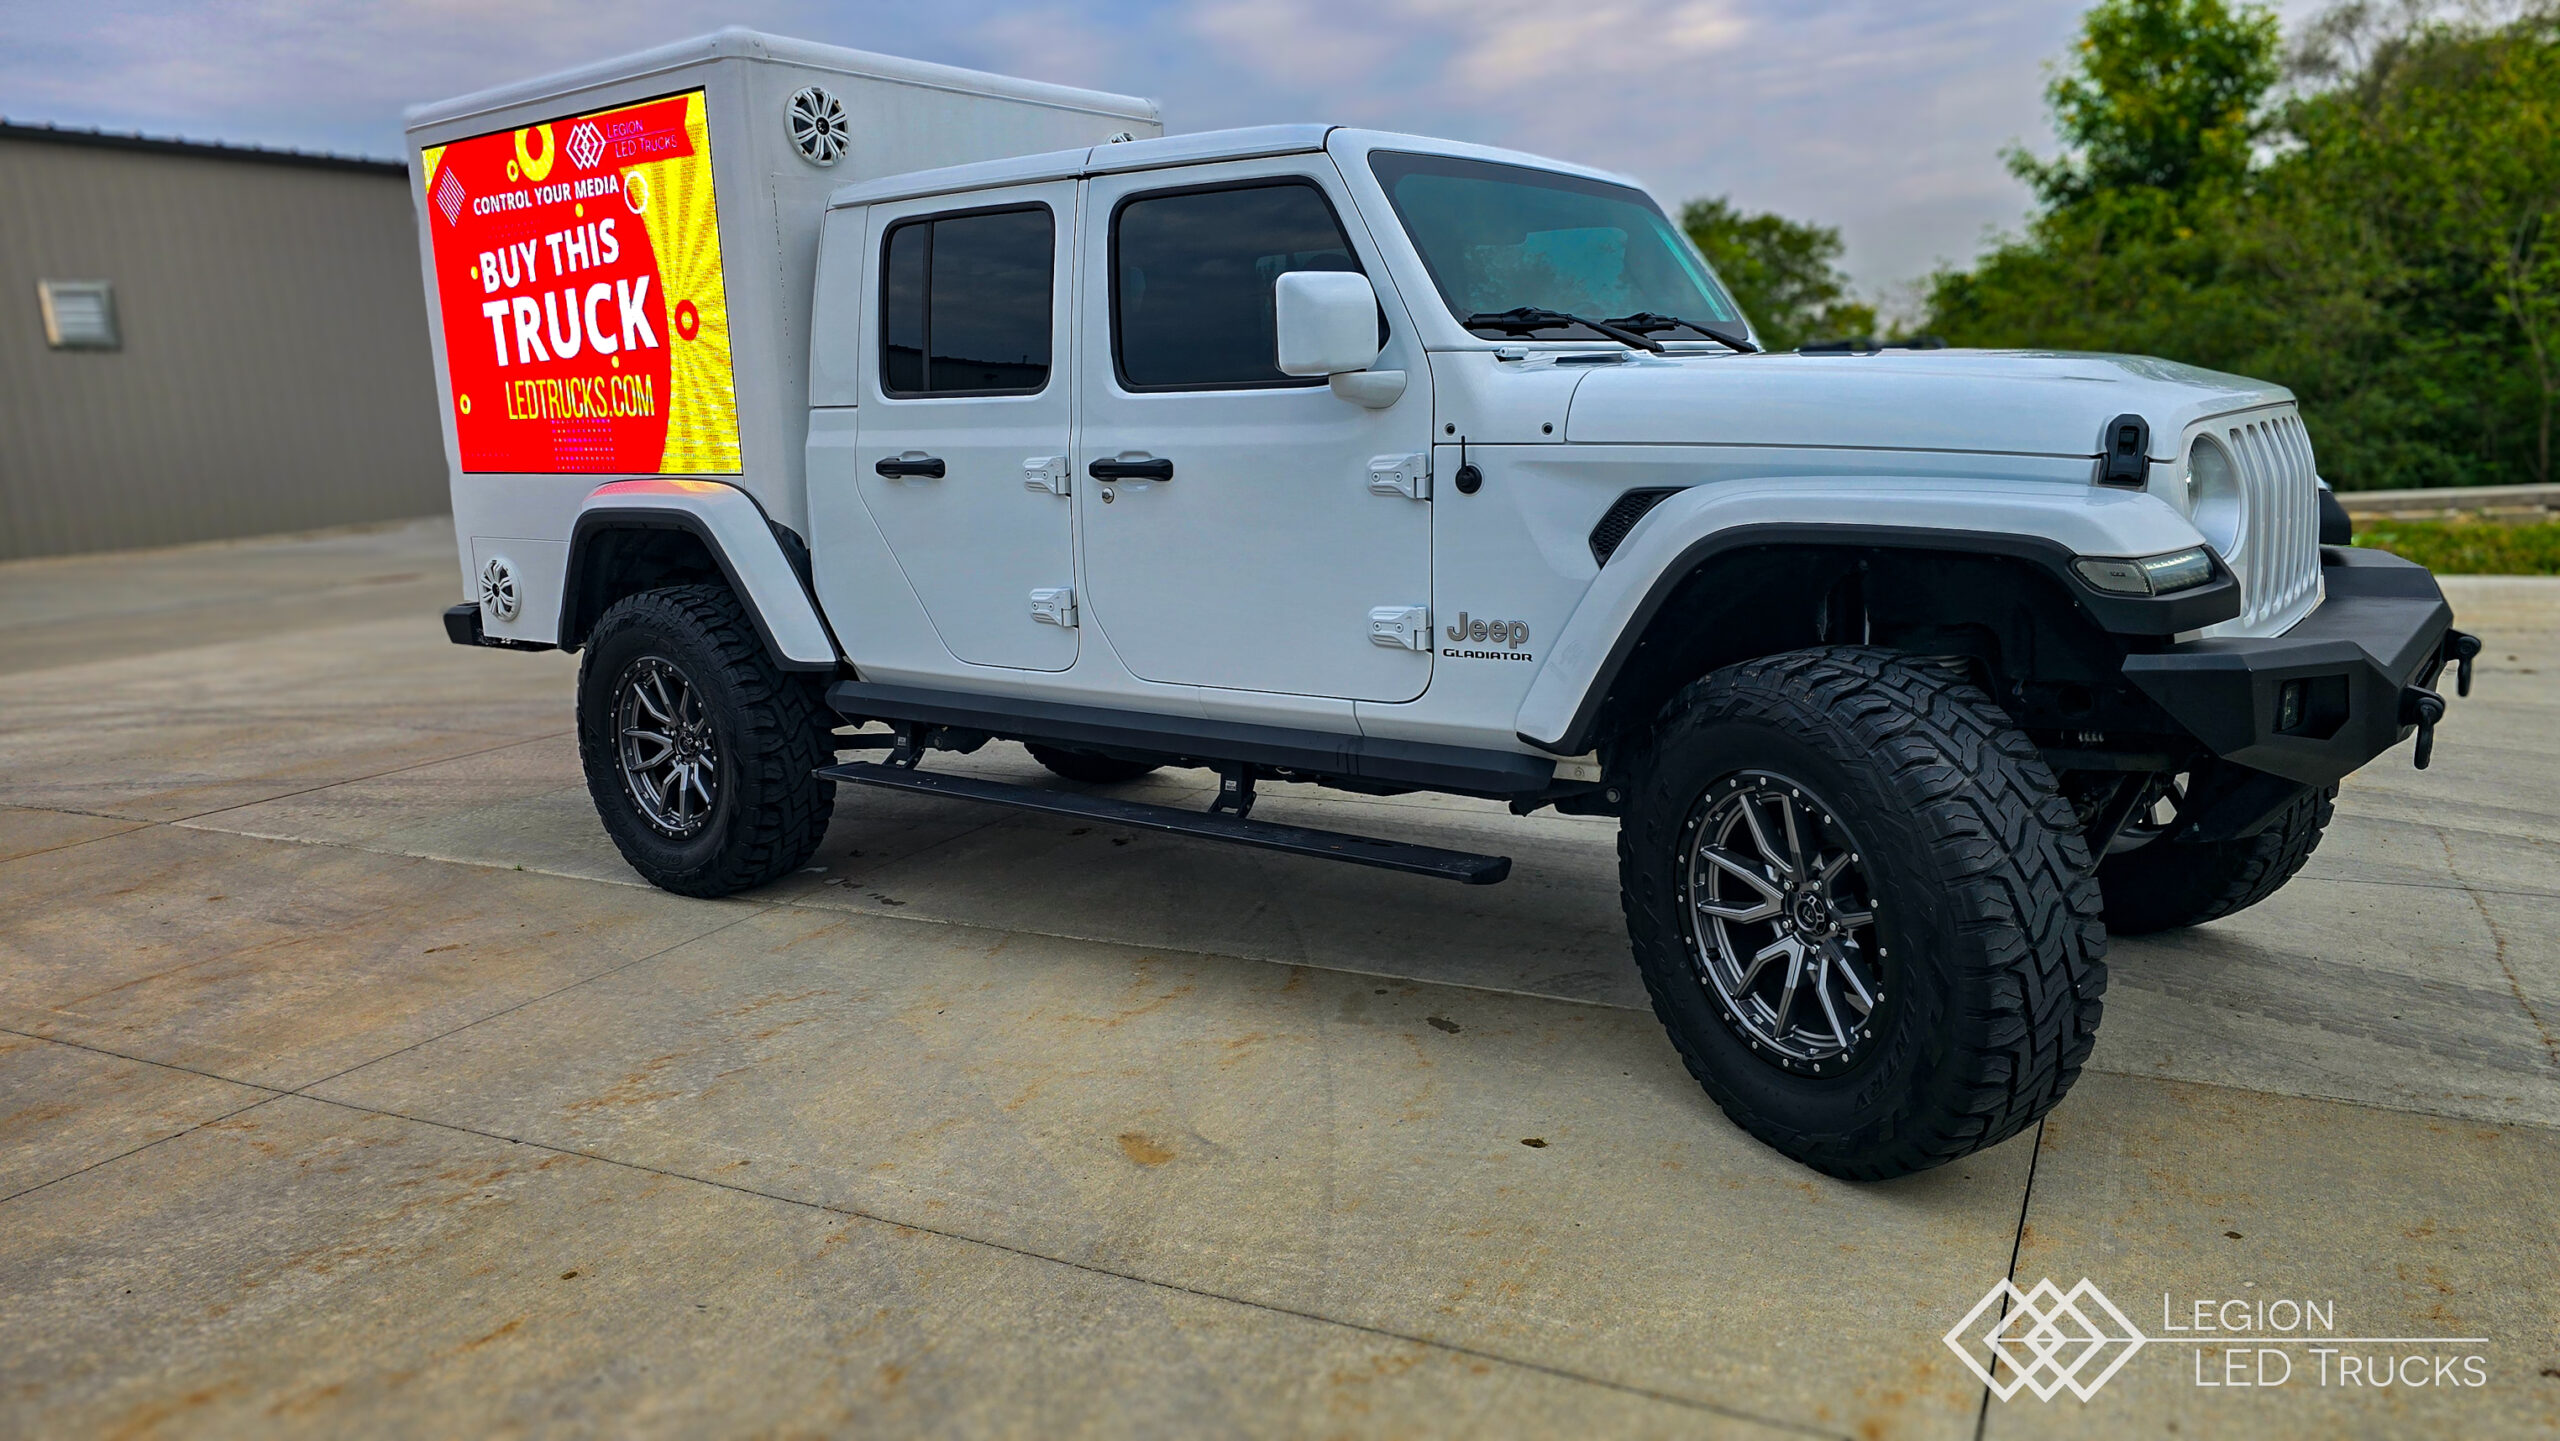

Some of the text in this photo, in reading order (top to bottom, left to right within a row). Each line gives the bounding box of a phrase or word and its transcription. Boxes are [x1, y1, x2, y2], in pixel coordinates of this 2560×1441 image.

[615, 134, 678, 158] LED TRUCKS
[473, 174, 620, 216] CONTROL YOUR MEDIA
[479, 217, 620, 294] BUY THIS
[482, 274, 659, 367] TRUCK
[505, 374, 655, 420] LEDTRUCKS.COM
[1446, 611, 1530, 649] Jeep
[1442, 648, 1533, 662] GLADIATOR
